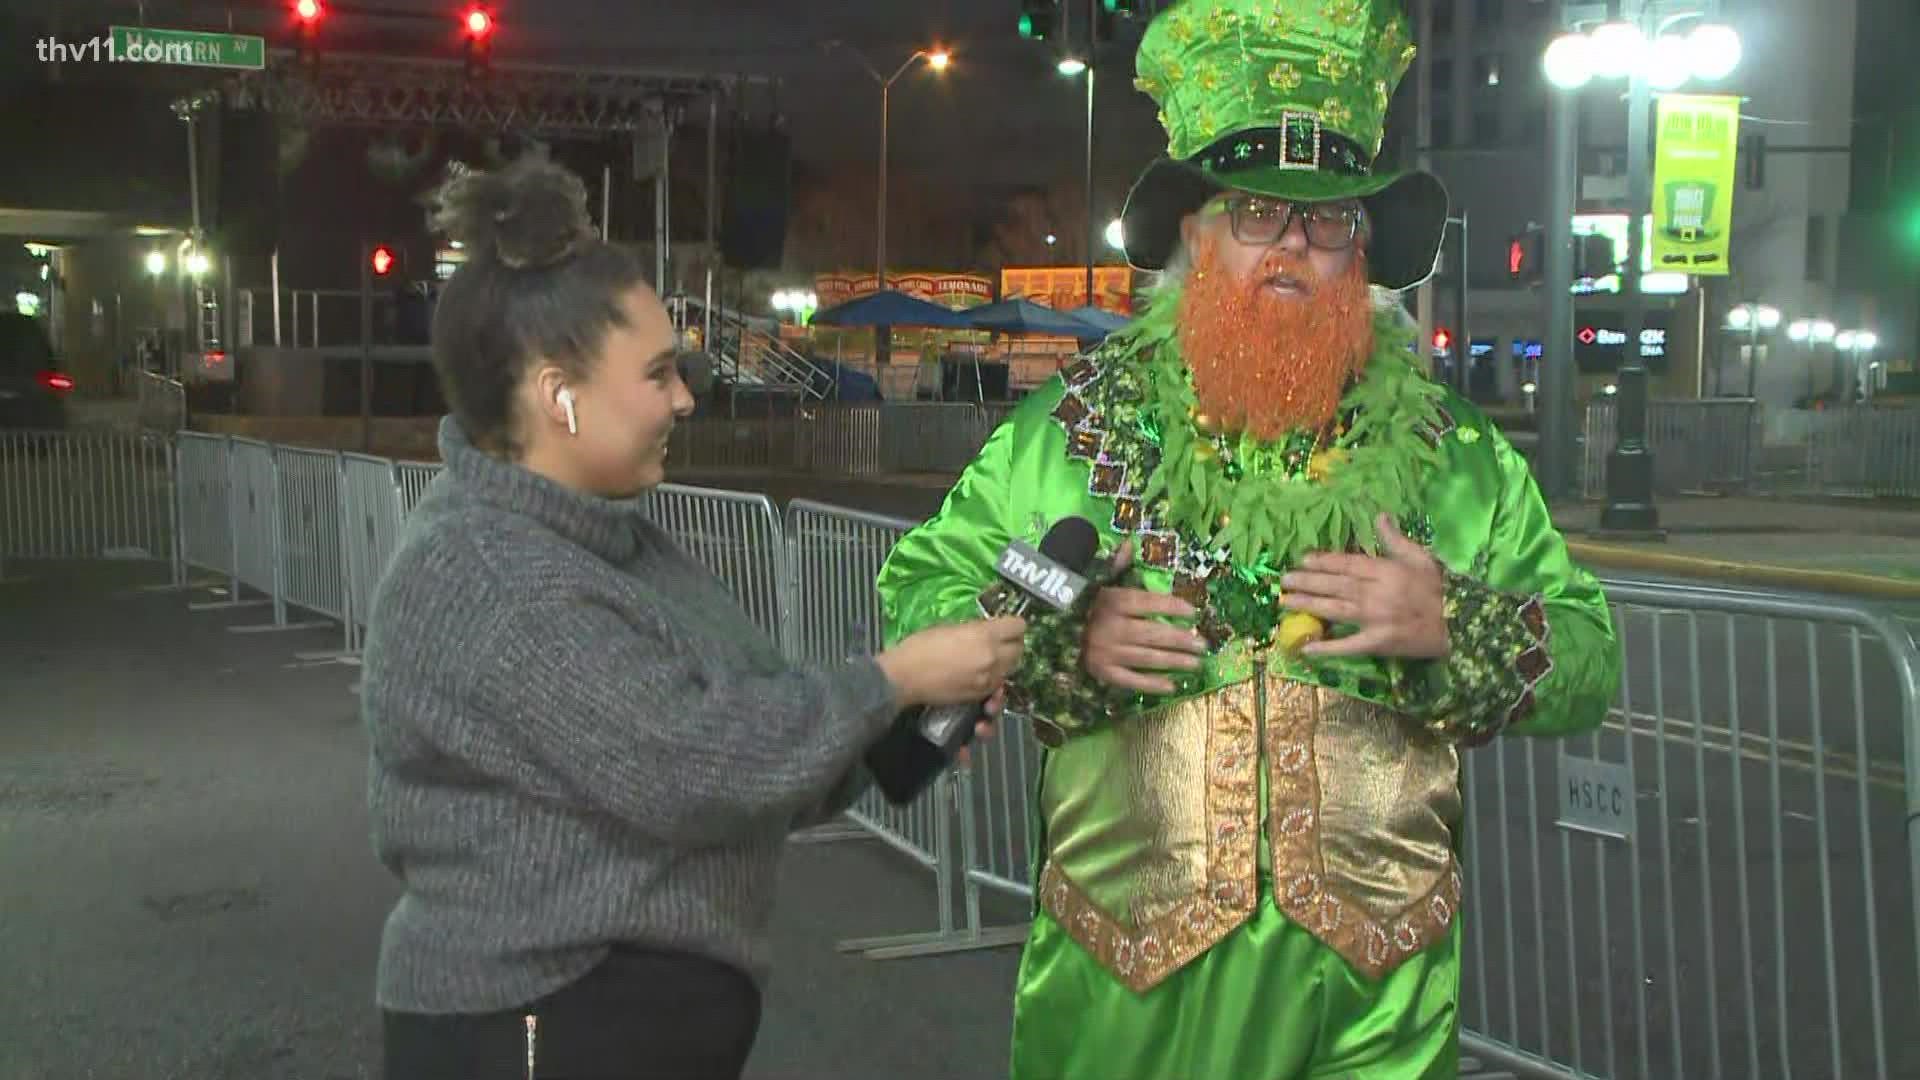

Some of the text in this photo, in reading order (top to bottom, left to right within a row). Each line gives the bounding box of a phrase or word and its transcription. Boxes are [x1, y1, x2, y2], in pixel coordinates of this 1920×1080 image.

[126, 31, 221, 64] MLRN
[1597, 329, 1625, 344] Ban
[1569, 779, 1622, 816] HSCC
